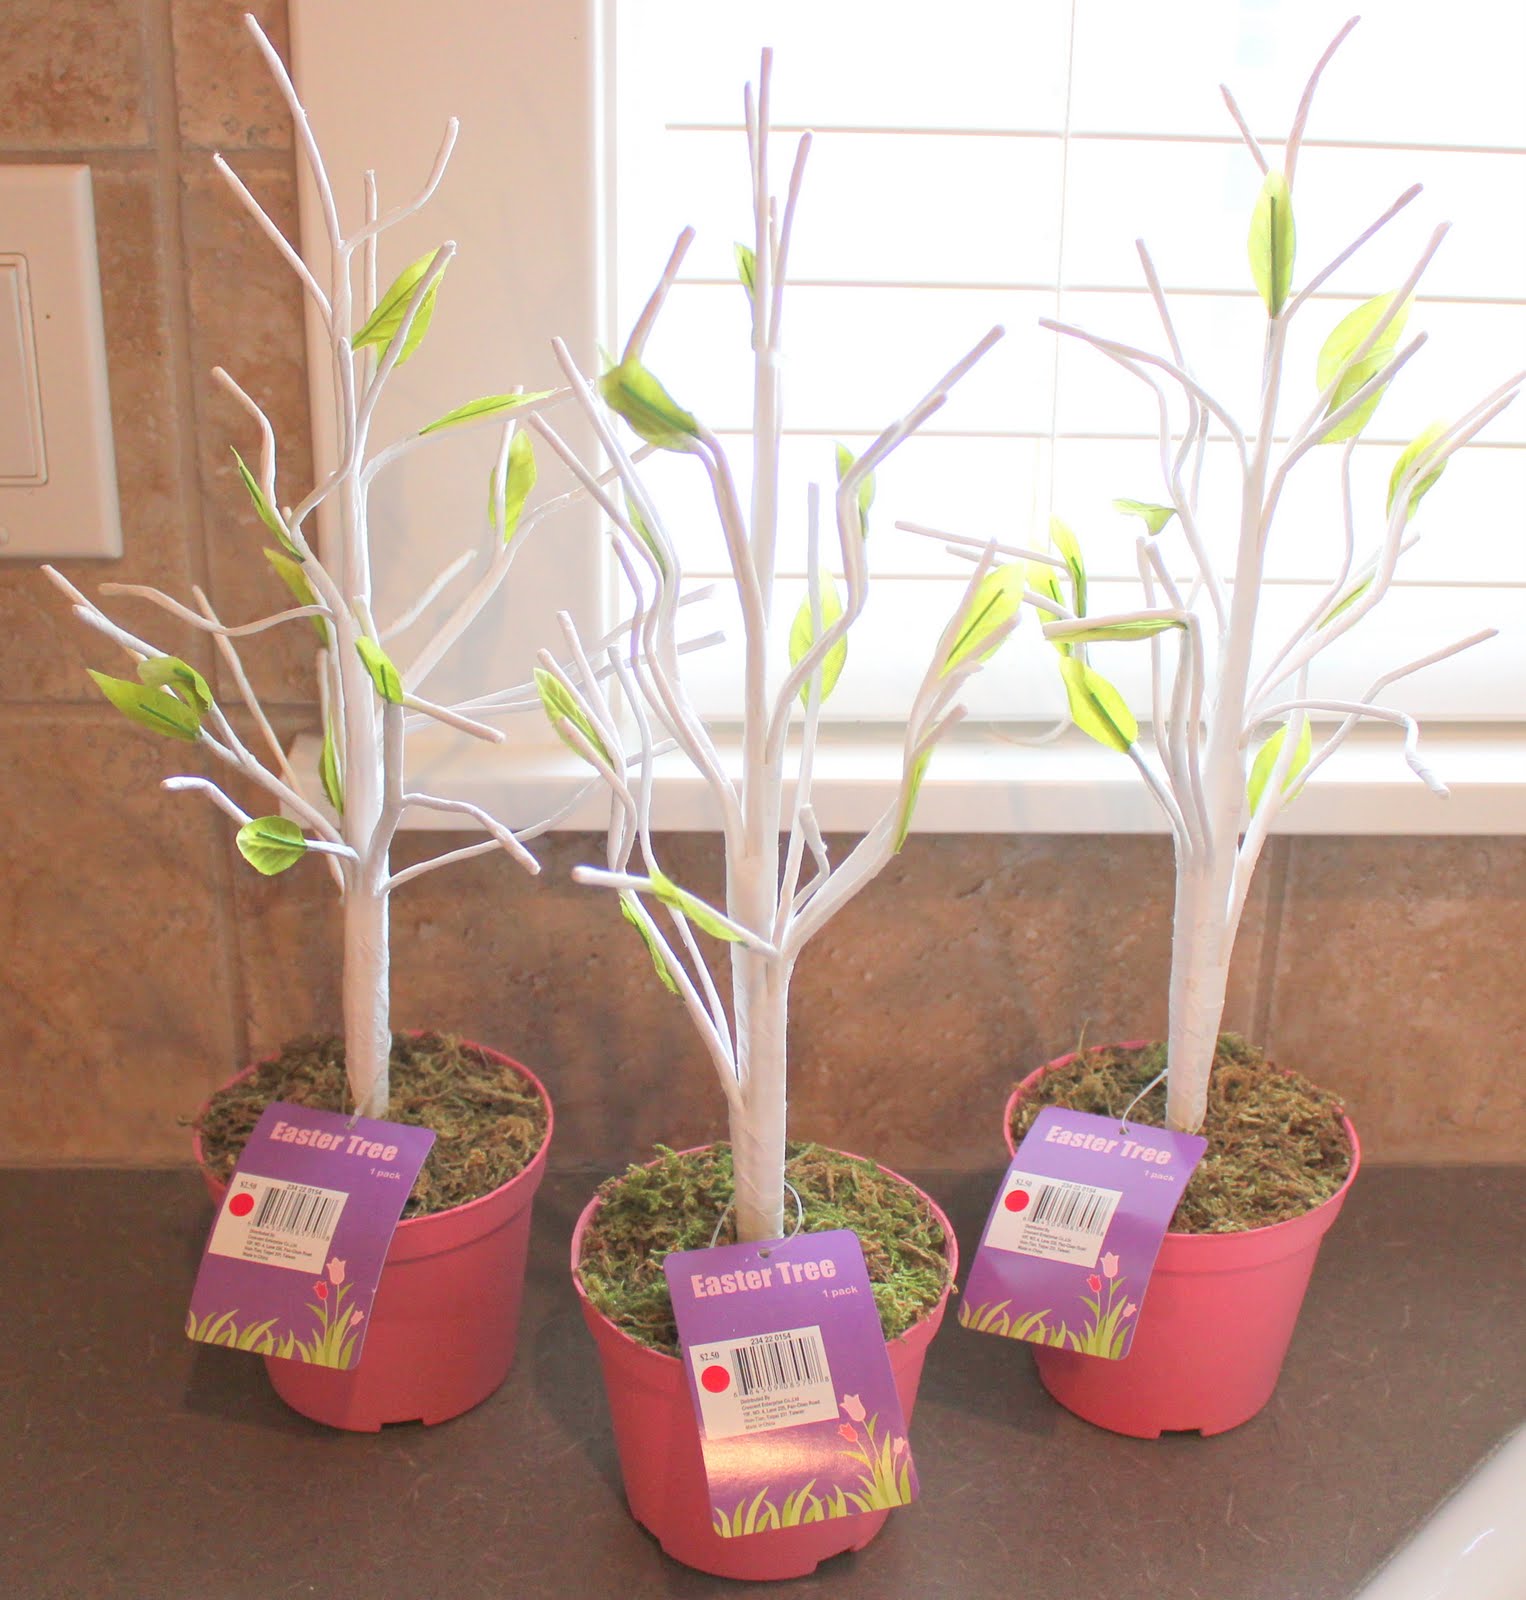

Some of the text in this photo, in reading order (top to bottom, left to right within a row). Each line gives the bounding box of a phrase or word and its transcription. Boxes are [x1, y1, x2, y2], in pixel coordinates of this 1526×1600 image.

[270, 1121, 398, 1161] Easter Tree
[1045, 1125, 1172, 1165] Easter Tree
[370, 1167, 401, 1180] 1 pack
[1150, 1171, 1175, 1182] pack
[307, 1187, 322, 1195] 0154
[690, 1259, 837, 1299] Easter Tree
[823, 1285, 858, 1299] 1 pack
[750, 1337, 763, 1345] 234
[774, 1332, 791, 1342] 0154
[699, 1351, 720, 1362] $2.50
